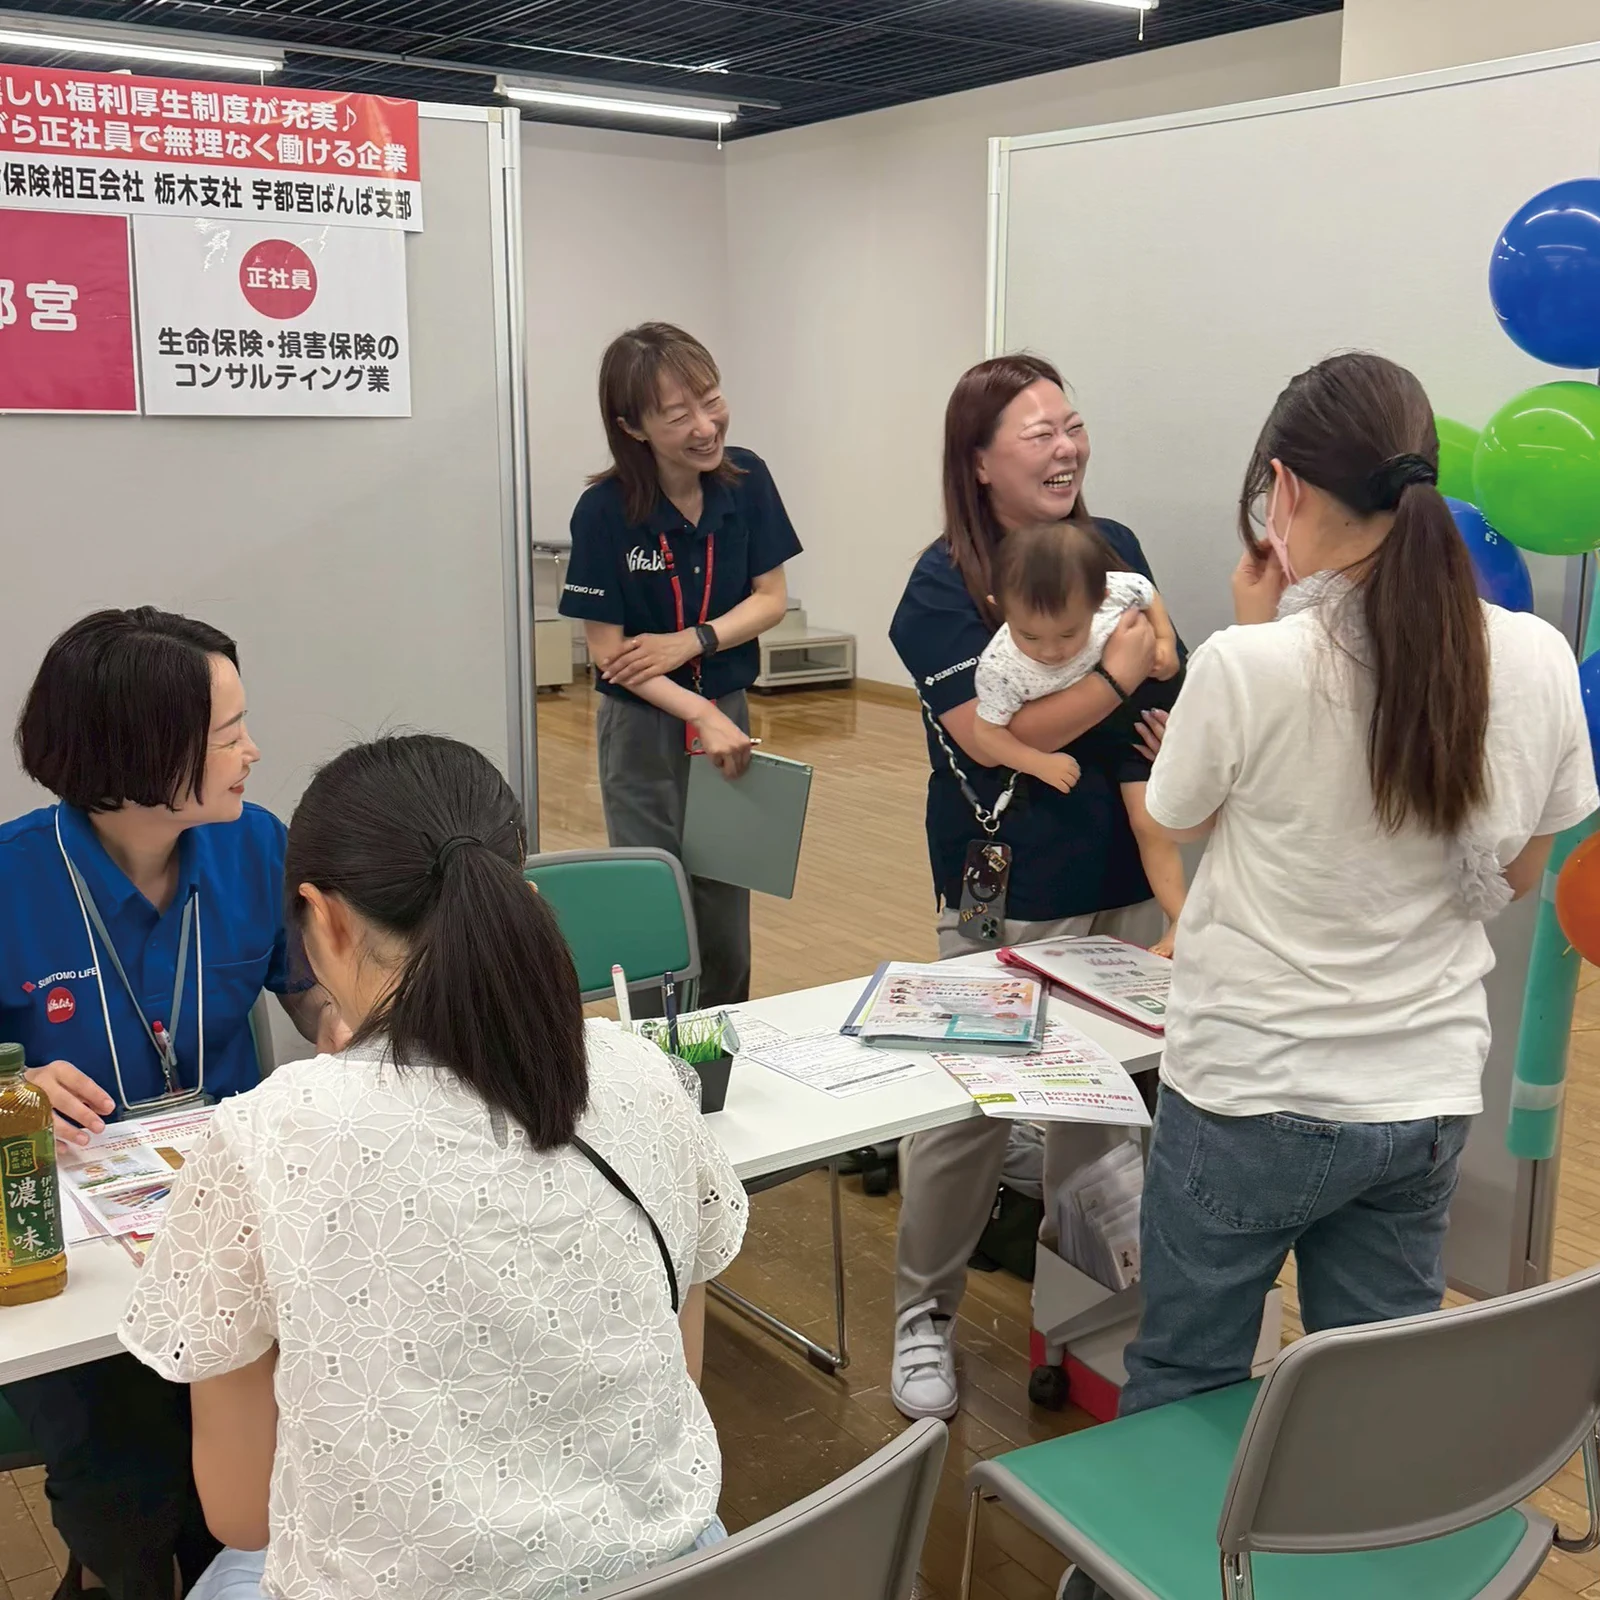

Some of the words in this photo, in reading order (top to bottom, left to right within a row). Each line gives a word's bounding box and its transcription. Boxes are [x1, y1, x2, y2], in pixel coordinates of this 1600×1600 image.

[0, 76, 337, 132] しい福利厚生制度が充実
[0, 162, 145, 202] 保険相互会社
[154, 172, 243, 208] 栃木支社
[252, 179, 412, 220] 宇都宮ばんば支部
[246, 267, 312, 291] 正社員
[158, 327, 399, 361] 生命保険・損害保険の
[175, 363, 390, 393] コンサルティング業
[588, 587, 605, 596] LIFE
[934, 657, 977, 681] SUMITOMO
[38, 971, 77, 989] SUMITOMO
[78, 966, 98, 979] LIFE
[7, 1176, 46, 1252] 濃い味
